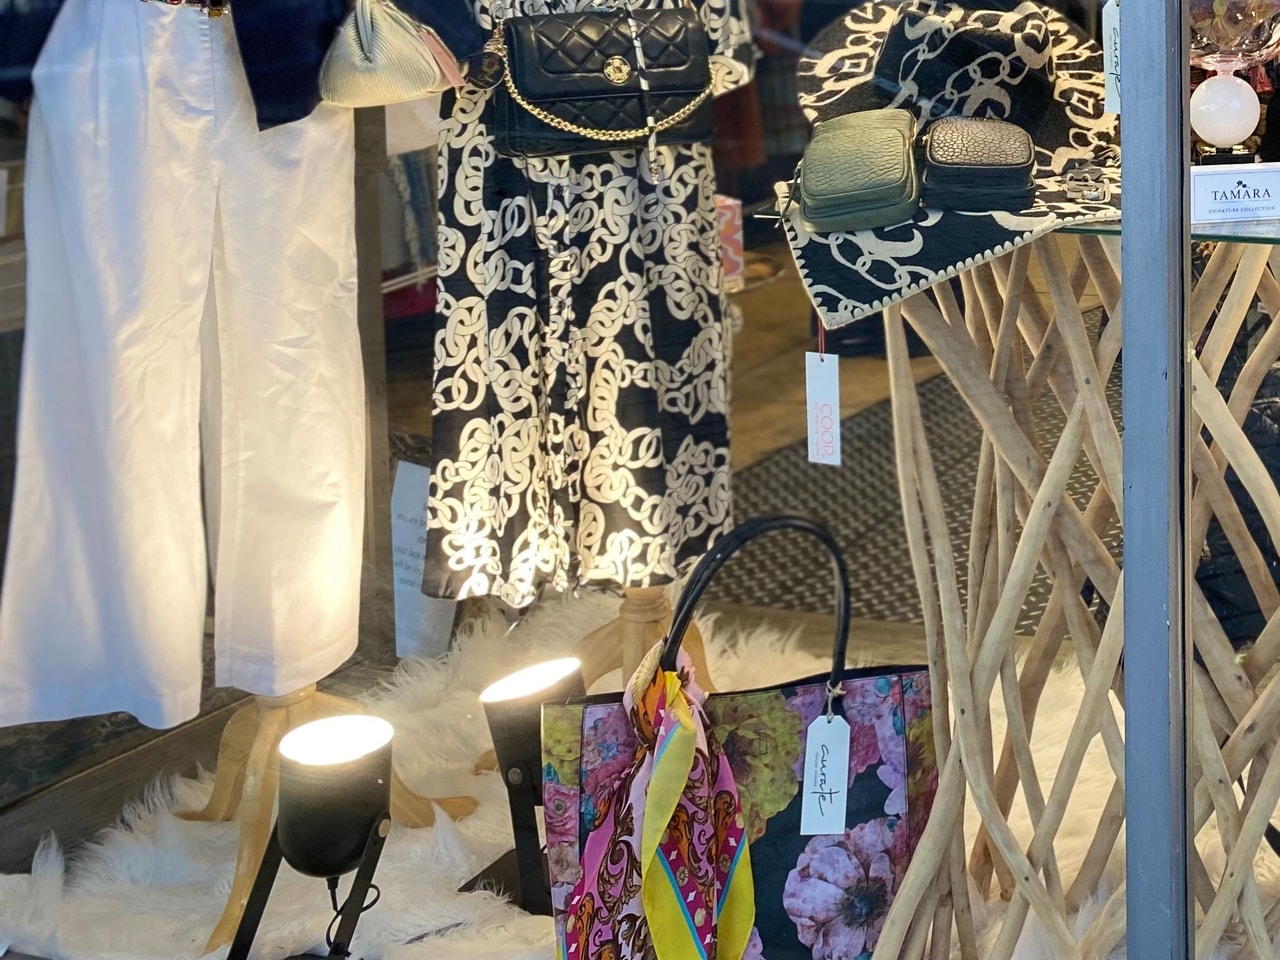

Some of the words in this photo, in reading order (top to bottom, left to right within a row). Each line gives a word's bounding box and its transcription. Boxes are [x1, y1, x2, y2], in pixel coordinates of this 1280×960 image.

[1211, 188, 1271, 201] TAMARA
[820, 403, 834, 457] COOP
[811, 744, 840, 817] curate
